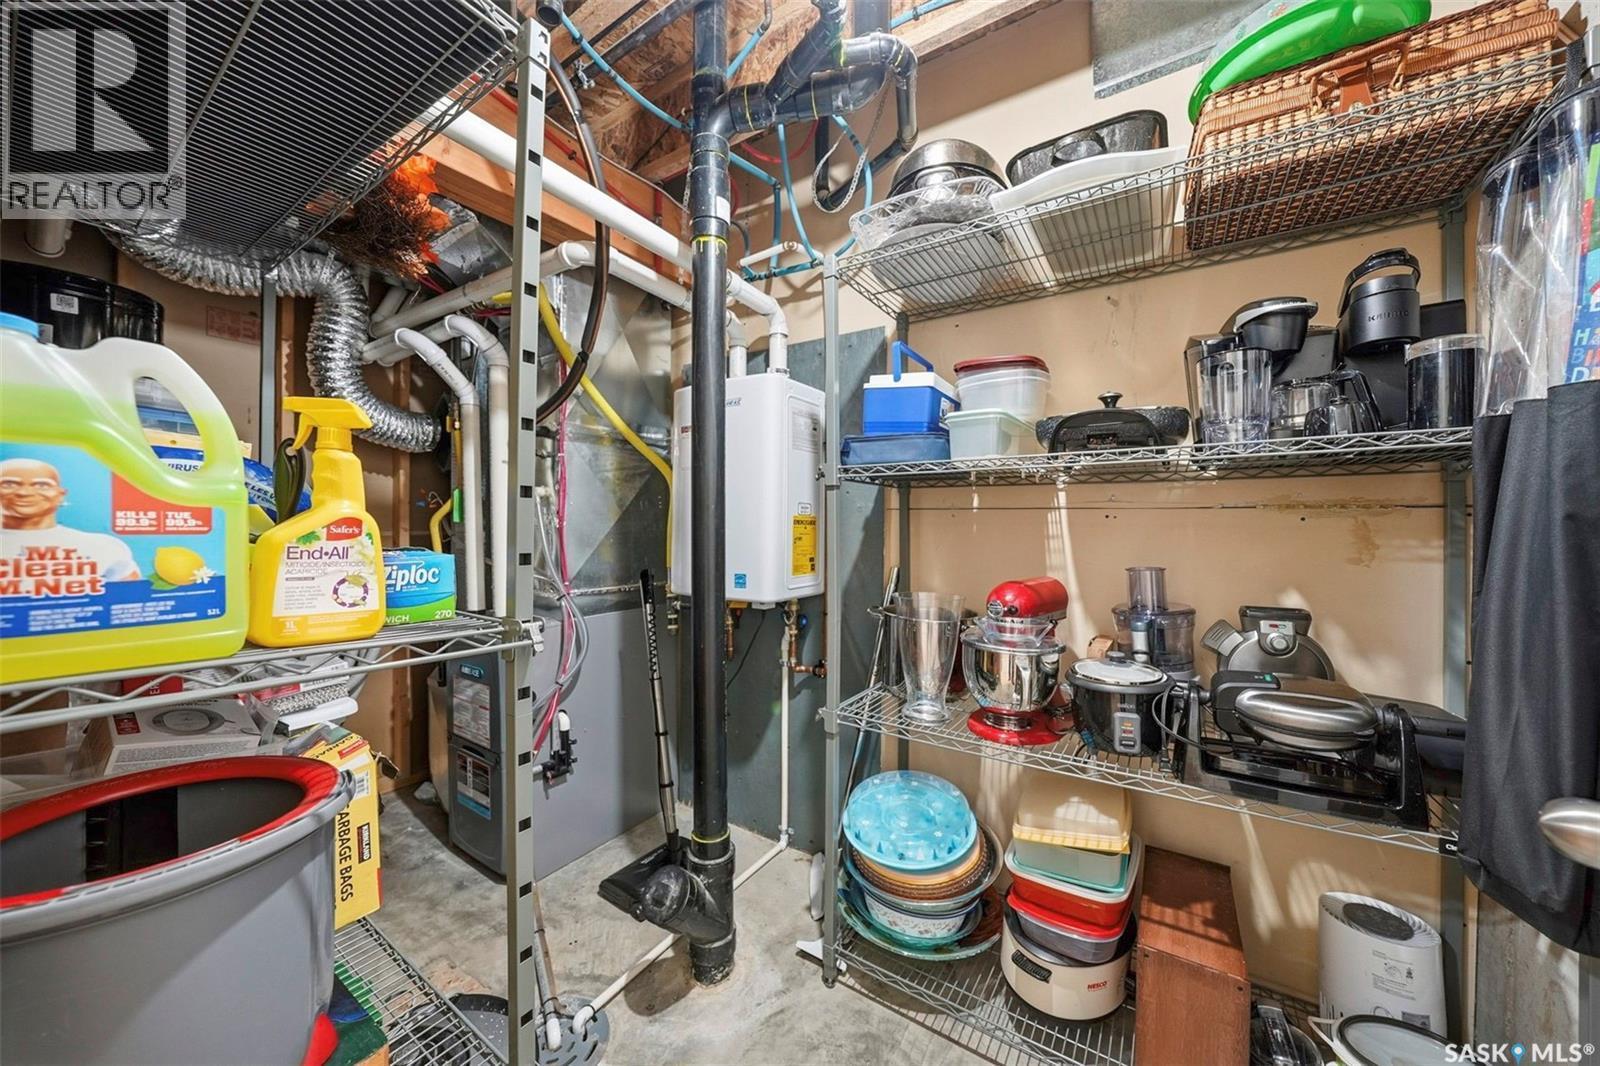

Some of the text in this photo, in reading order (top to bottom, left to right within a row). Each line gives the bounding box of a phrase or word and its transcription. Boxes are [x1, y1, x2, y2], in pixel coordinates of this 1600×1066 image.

[167, 463, 200, 472] IRUS
[25, 546, 82, 560] Mr.
[435, 609, 453, 619] 270
[337, 804, 354, 902] ARBAGE BAGS
